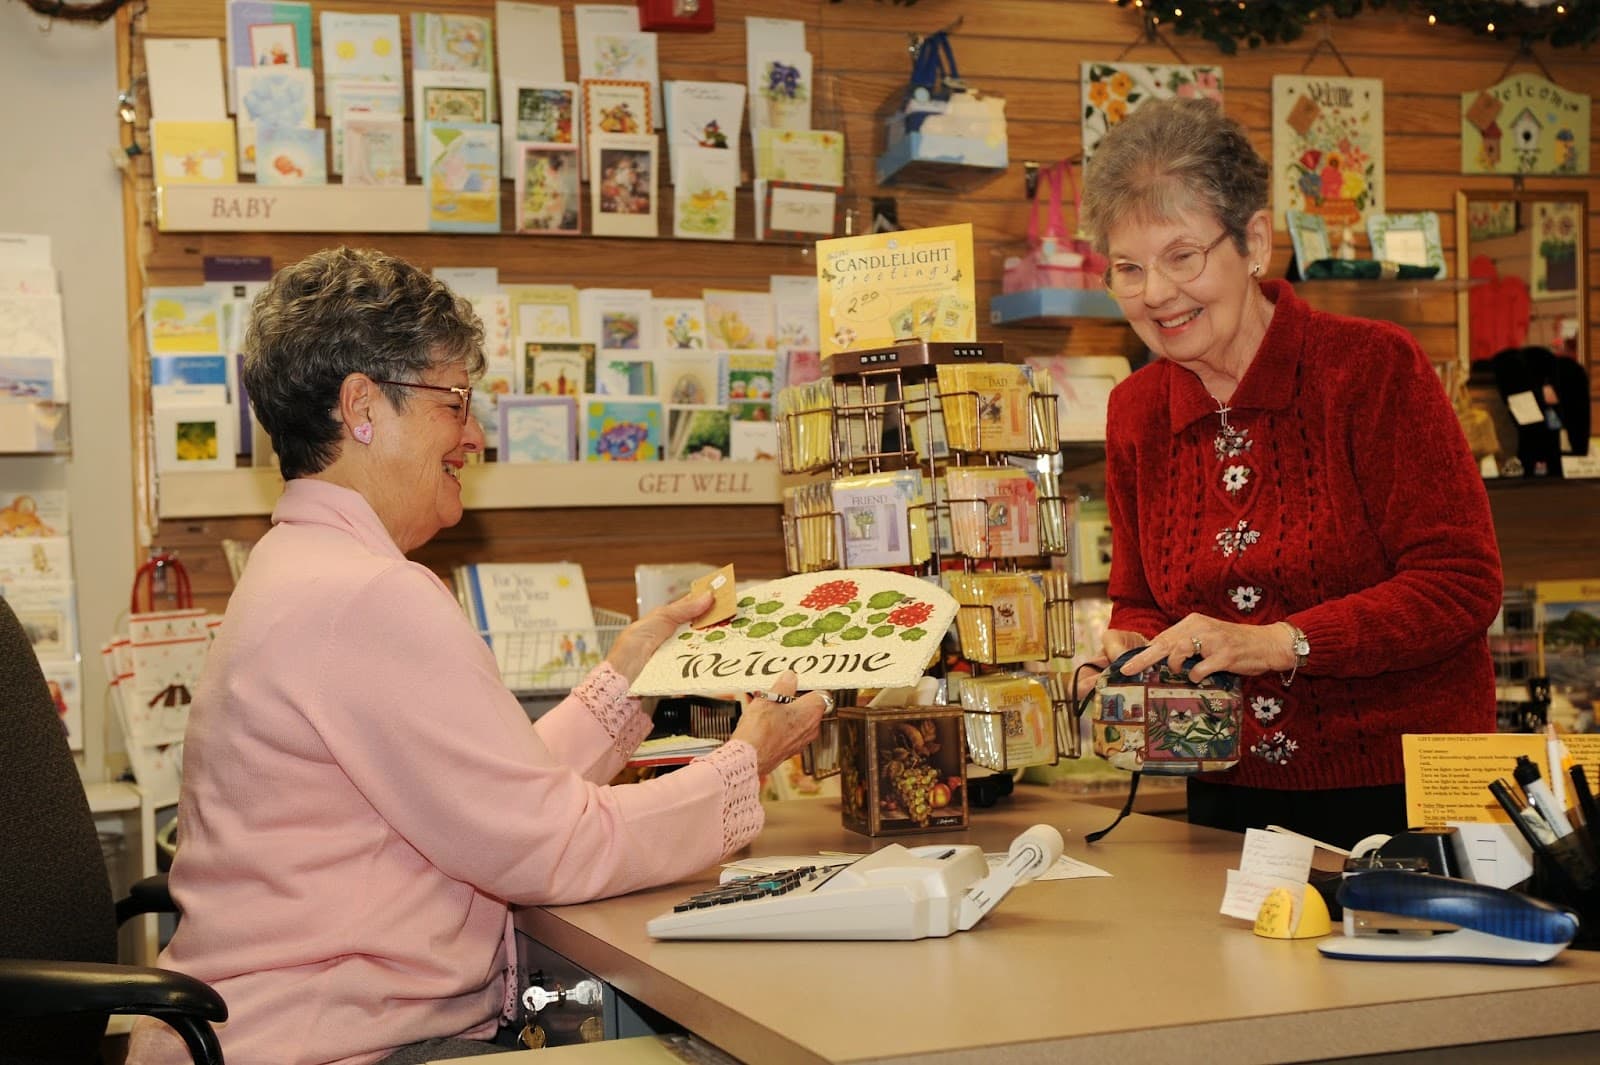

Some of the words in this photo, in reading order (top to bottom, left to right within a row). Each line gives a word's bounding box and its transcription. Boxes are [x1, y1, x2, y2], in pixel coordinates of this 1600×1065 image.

[211, 197, 278, 219] BABY
[835, 248, 951, 273] CANDLELIGHT
[837, 264, 950, 290] greetings
[638, 472, 687, 495] GET
[691, 472, 754, 494] WELL
[850, 495, 888, 505] FRIEND
[677, 651, 896, 679] Welcome
